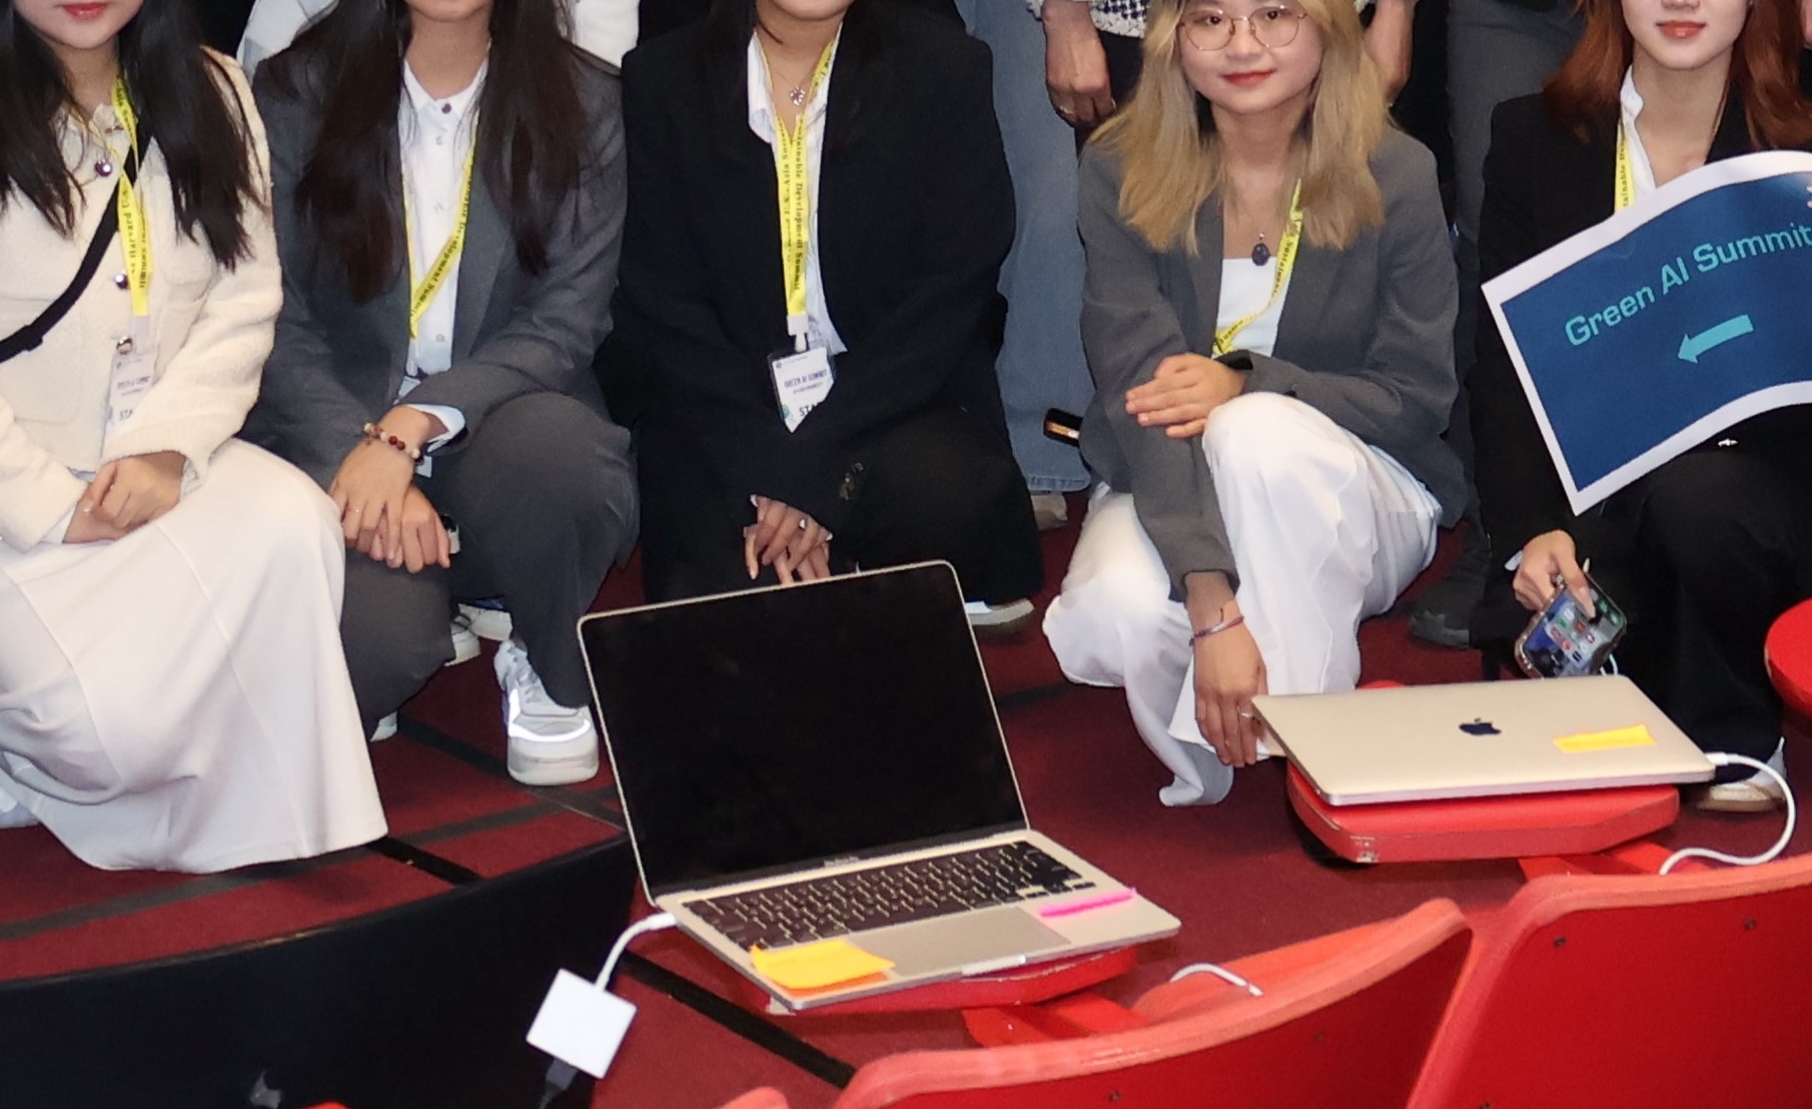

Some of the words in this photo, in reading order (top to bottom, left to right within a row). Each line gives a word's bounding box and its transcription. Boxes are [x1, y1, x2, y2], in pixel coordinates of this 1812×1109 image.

[795, 173, 805, 247] Development
[795, 249, 803, 291] Summit
[1564, 285, 1656, 346] Green
[1661, 256, 1690, 295] AI
